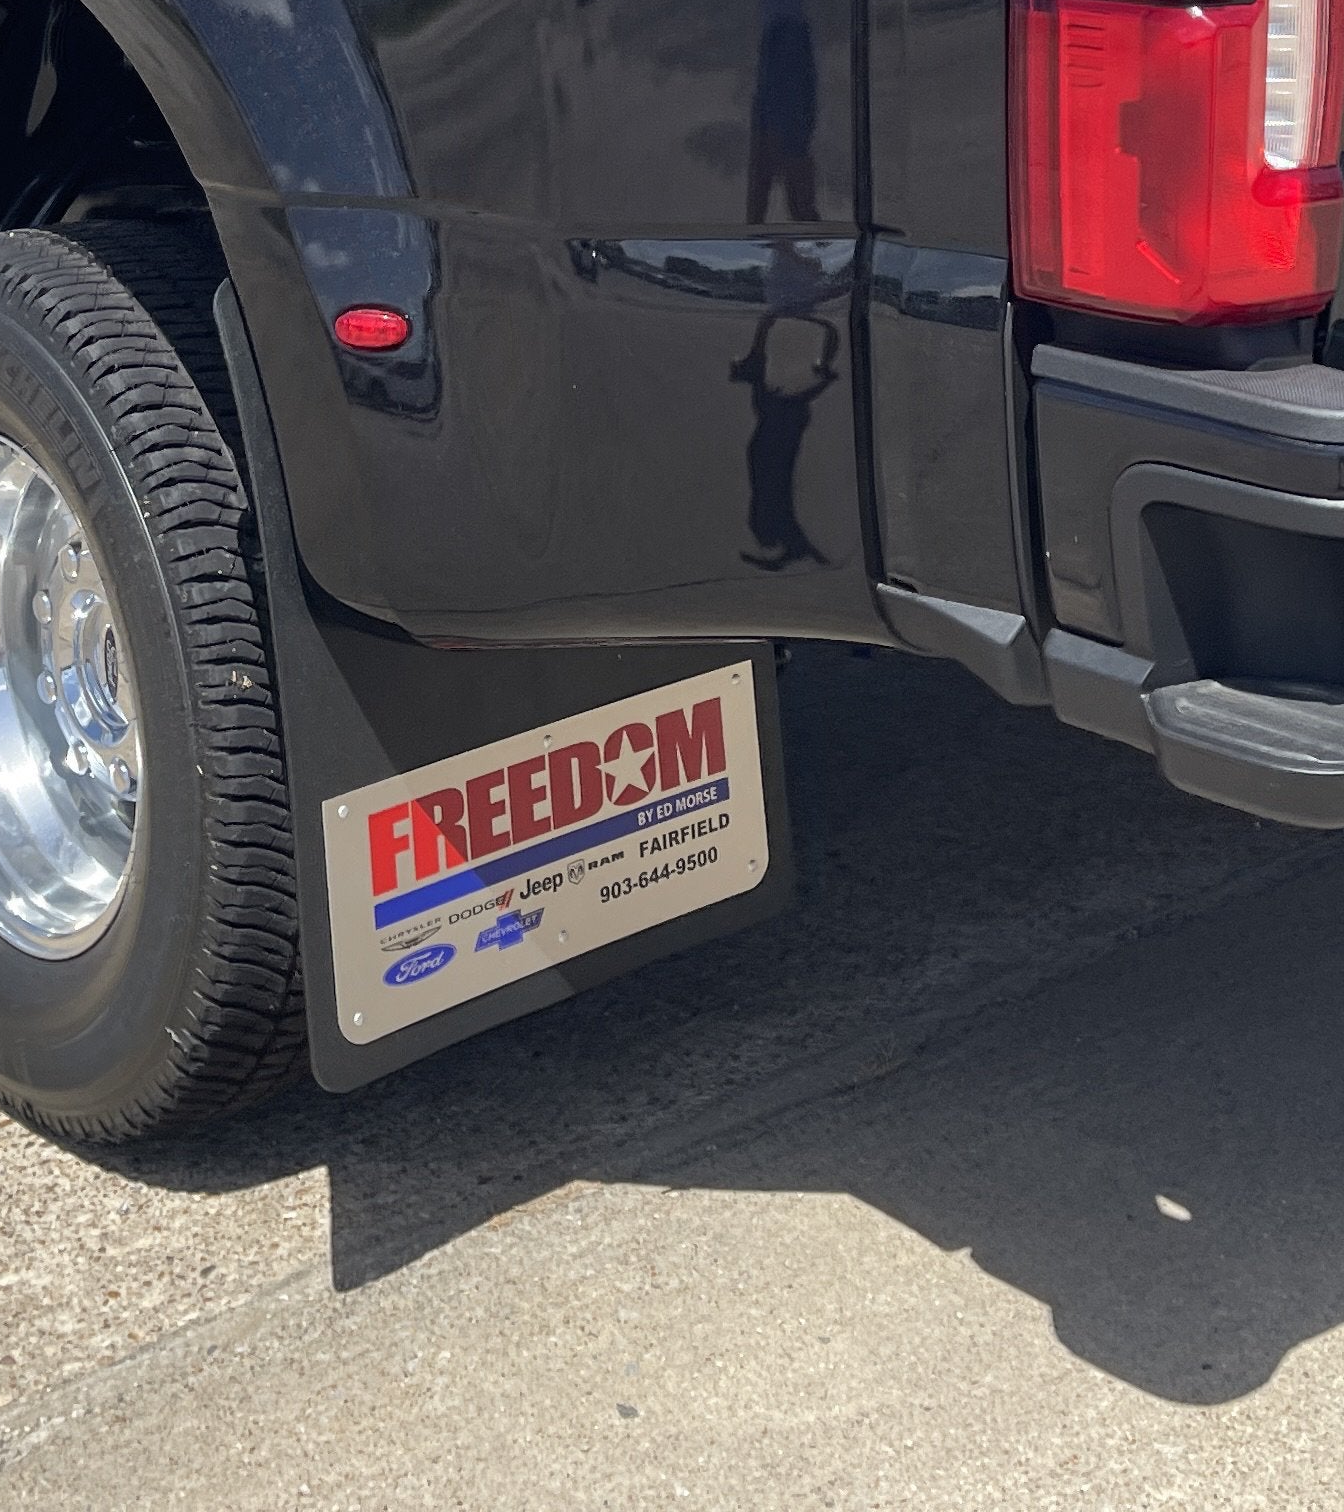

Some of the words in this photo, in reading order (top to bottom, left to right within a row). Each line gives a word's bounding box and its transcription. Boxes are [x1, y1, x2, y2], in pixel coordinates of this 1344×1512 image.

[368, 697, 727, 897] FREEDOM
[637, 809, 654, 827] BY
[656, 802, 673, 820] ED
[675, 787, 718, 812] MORSE
[639, 813, 731, 858] FAIRFIELD
[587, 850, 625, 870] RAM
[600, 846, 719, 904] 903-644-9500
[519, 871, 564, 900] Jeep
[448, 895, 508, 925] DODGE
[380, 916, 443, 945] CHRYSLER
[395, 950, 446, 983] Ford
